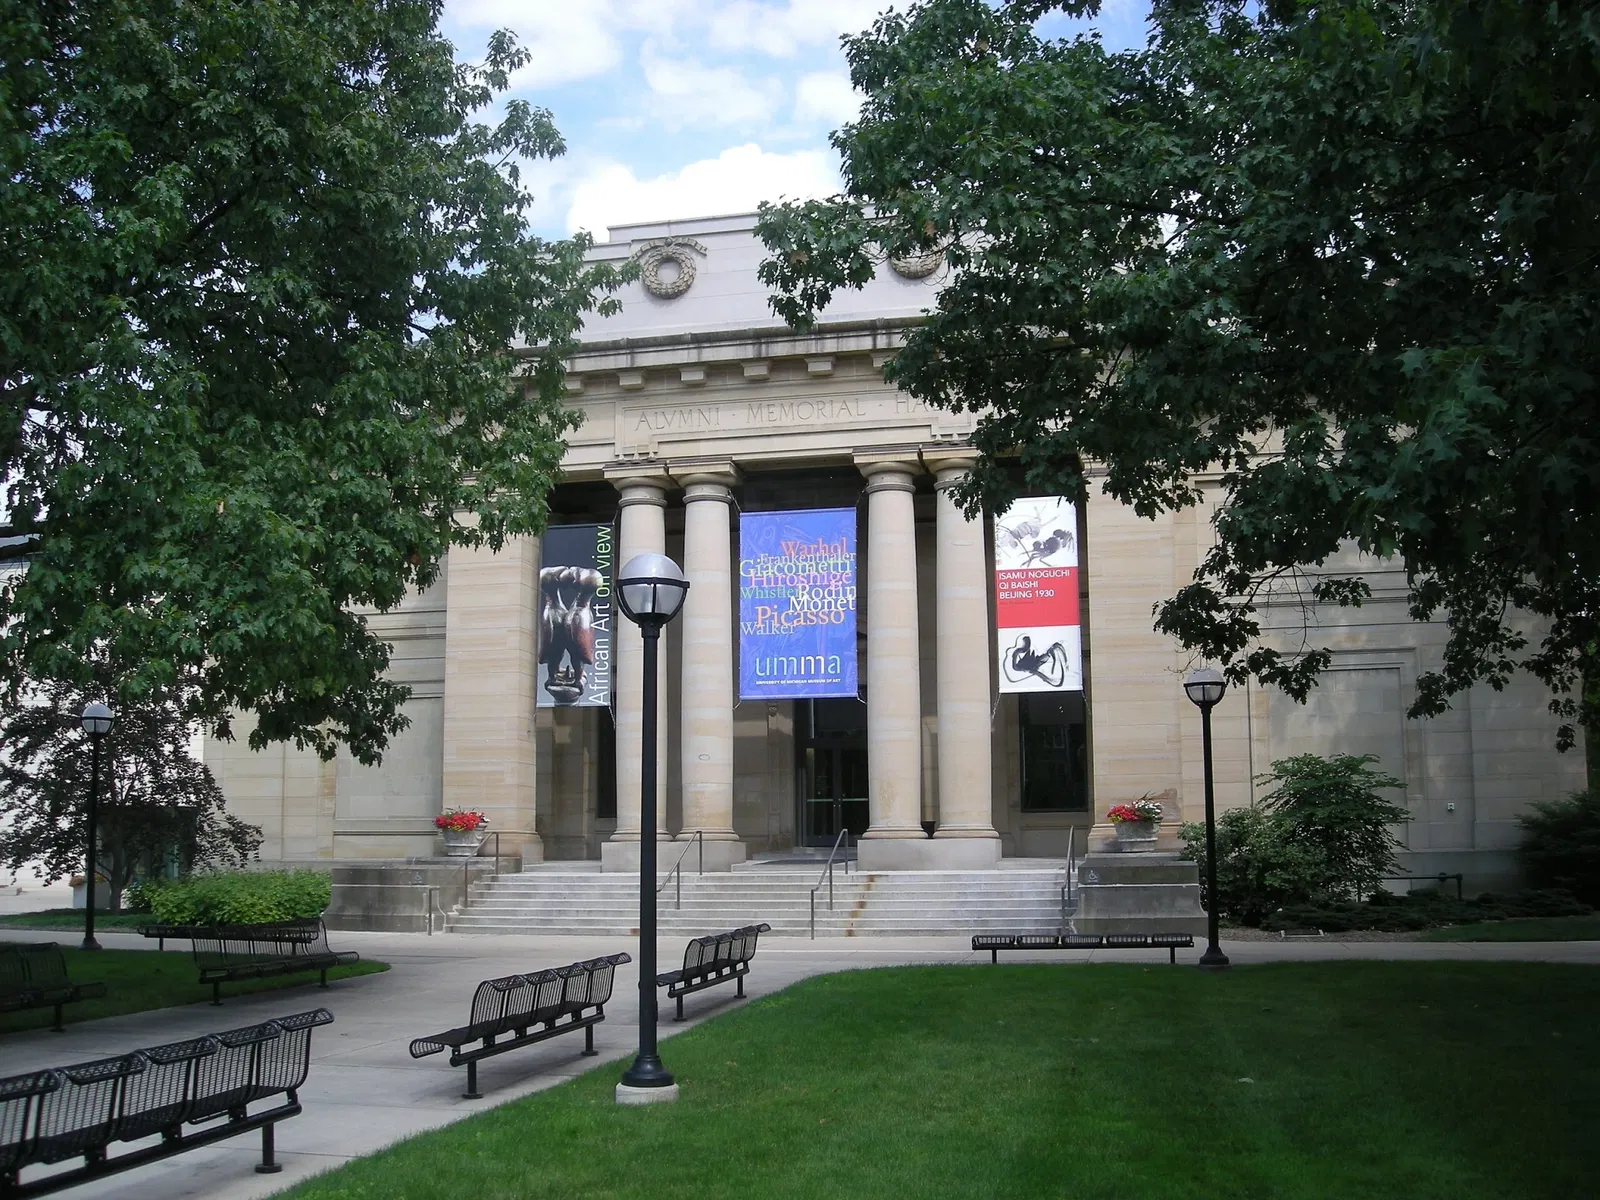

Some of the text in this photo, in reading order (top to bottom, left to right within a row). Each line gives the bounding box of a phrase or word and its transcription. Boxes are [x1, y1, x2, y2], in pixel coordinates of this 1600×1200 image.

[634, 392, 950, 431] ALVMNI MEMORIAL HA
[781, 537, 847, 557] Warhol
[760, 549, 857, 566] Frankenthaler
[739, 558, 852, 577] Giacometti
[999, 569, 1070, 580] ISAMU NOGUCHI
[750, 567, 852, 590] Hiroshige
[999, 580, 1038, 590] QI BAISHI
[797, 582, 857, 600] Rodin
[999, 589, 1055, 599] BEIJING 1930
[788, 594, 856, 613] Monet
[588, 526, 611, 706] African Art on view
[755, 604, 845, 627] Picasso
[740, 620, 796, 636] Walker
[755, 655, 841, 676] umma
